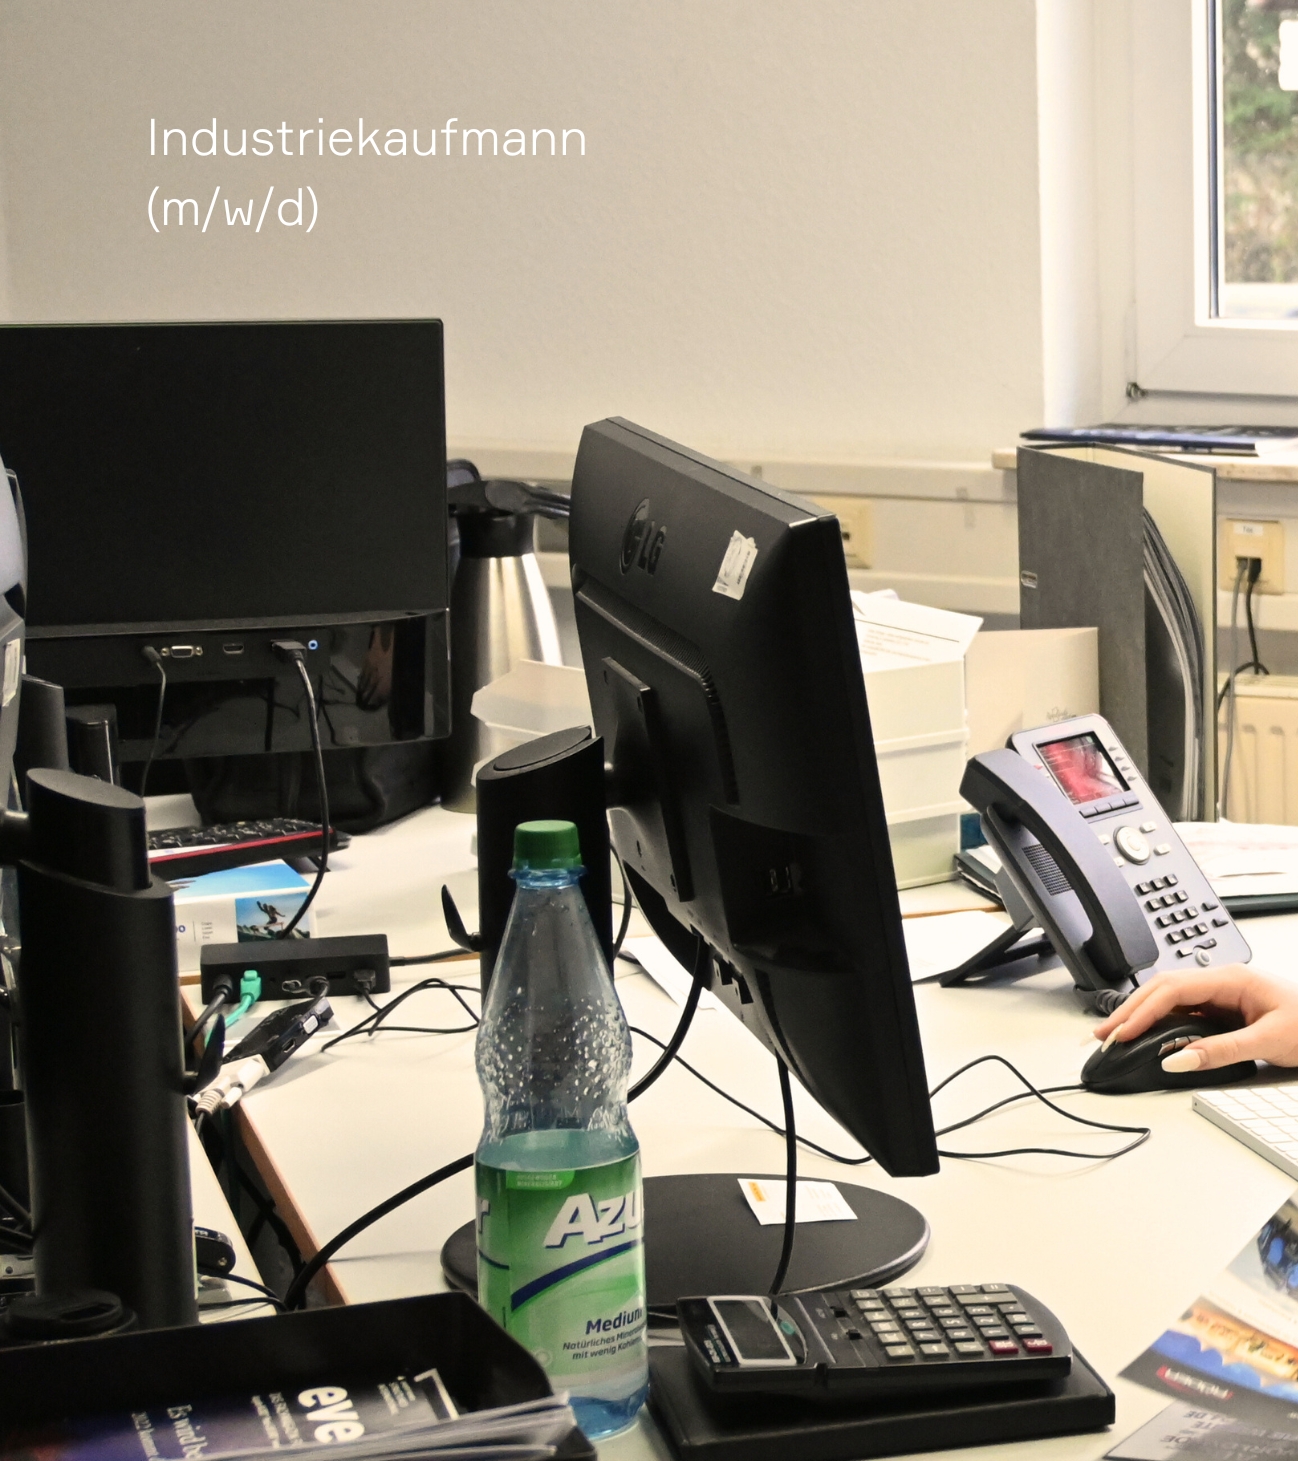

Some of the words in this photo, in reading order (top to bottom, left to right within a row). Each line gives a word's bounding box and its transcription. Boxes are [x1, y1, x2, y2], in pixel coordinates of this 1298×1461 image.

[572, 1351, 589, 1360] mit
[590, 1345, 617, 1358] wenig
[297, 1385, 365, 1444] eve
